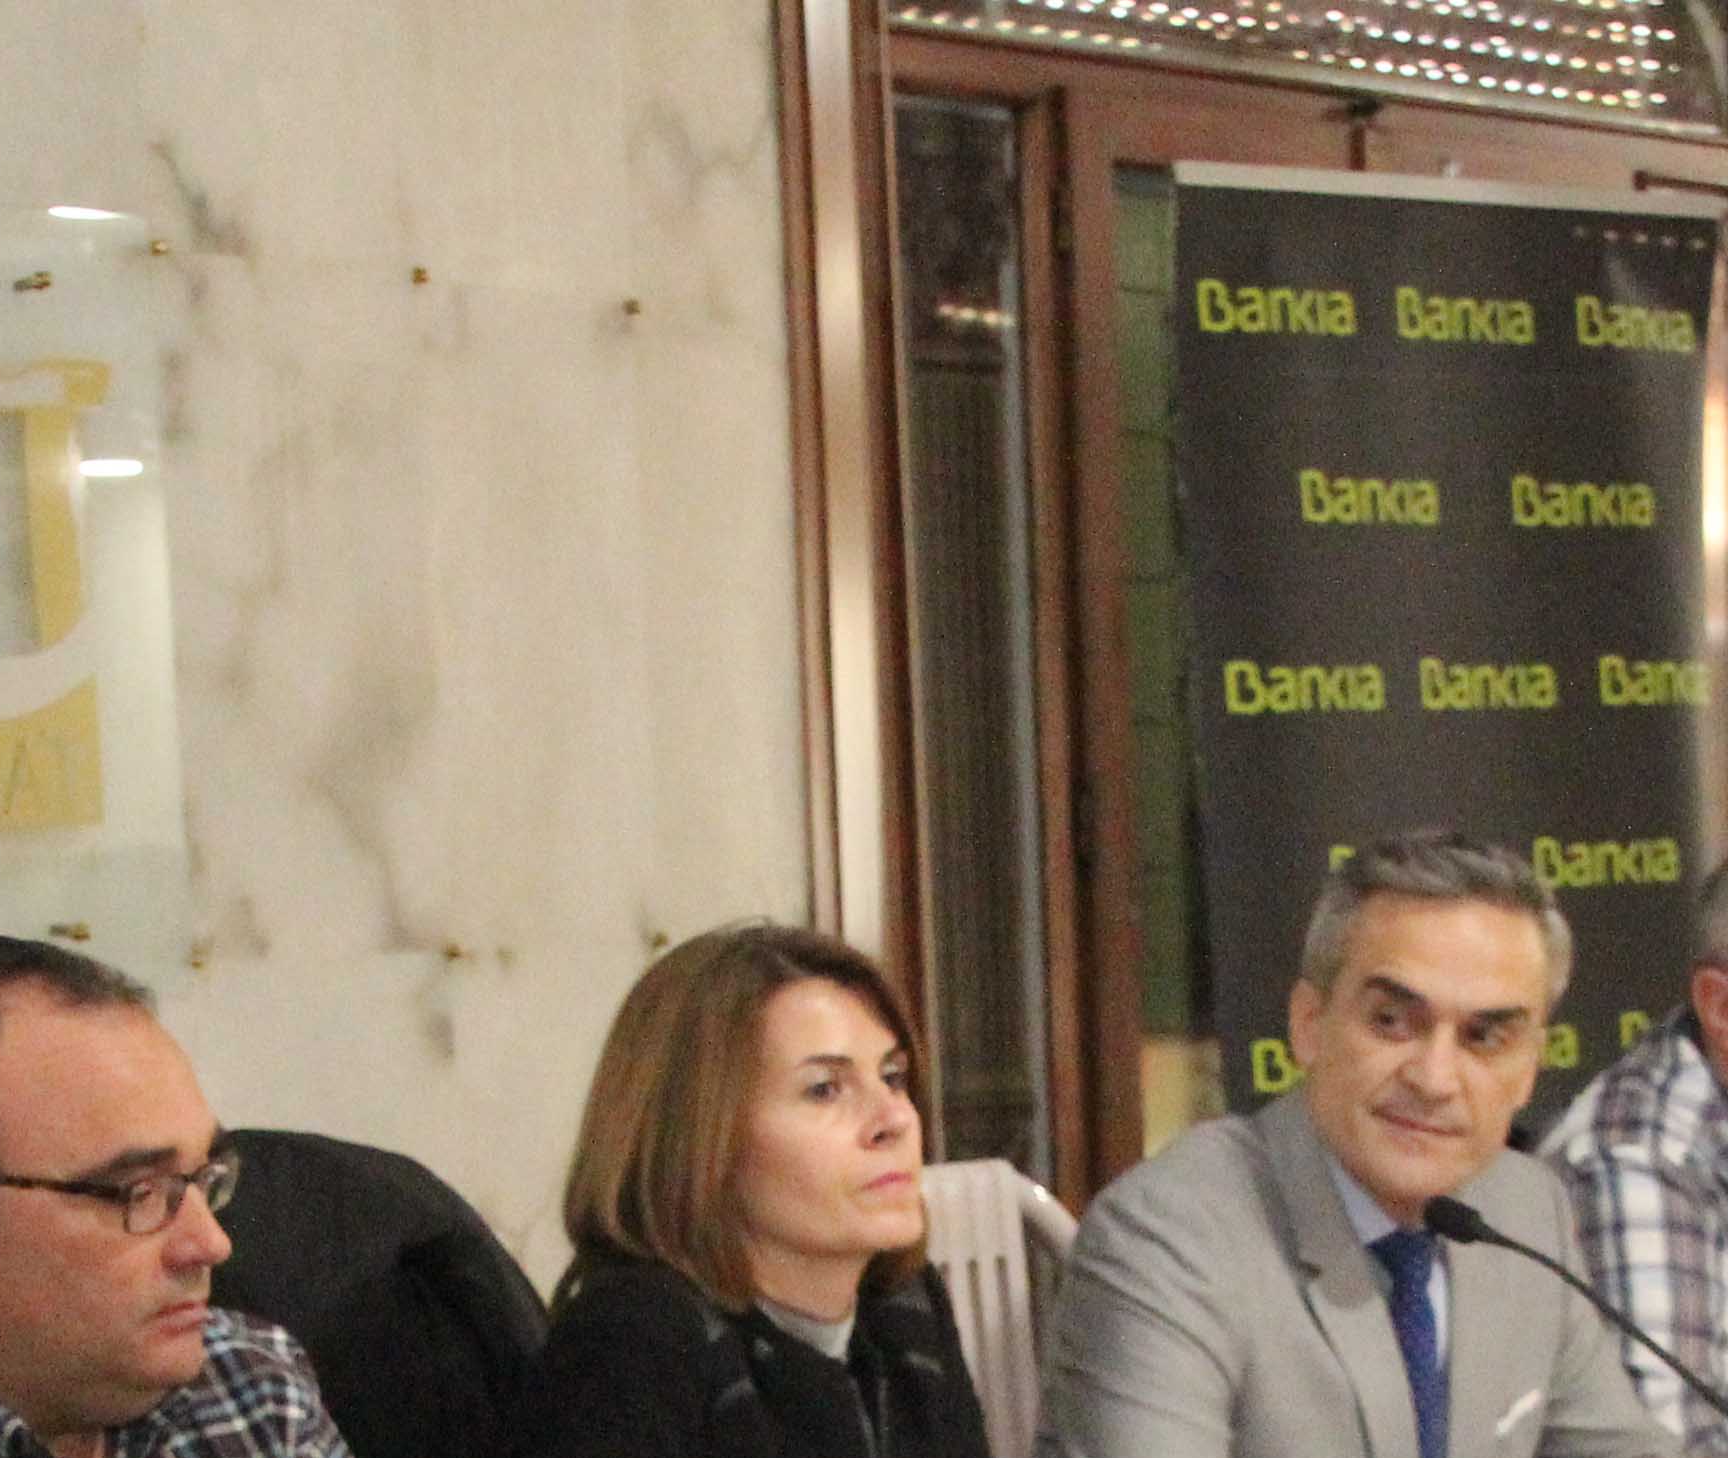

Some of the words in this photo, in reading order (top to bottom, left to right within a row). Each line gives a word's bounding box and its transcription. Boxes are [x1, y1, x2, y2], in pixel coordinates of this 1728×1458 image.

[1196, 278, 1358, 338] Bankia
[1394, 286, 1537, 347] Bankia
[1575, 295, 1698, 354] Bankia
[1299, 468, 1441, 526] Bankia
[1510, 475, 1656, 528] Bankia
[1223, 660, 1387, 715] Bankia
[1419, 656, 1559, 709] Bankia
[1532, 835, 1681, 888] Bankia
